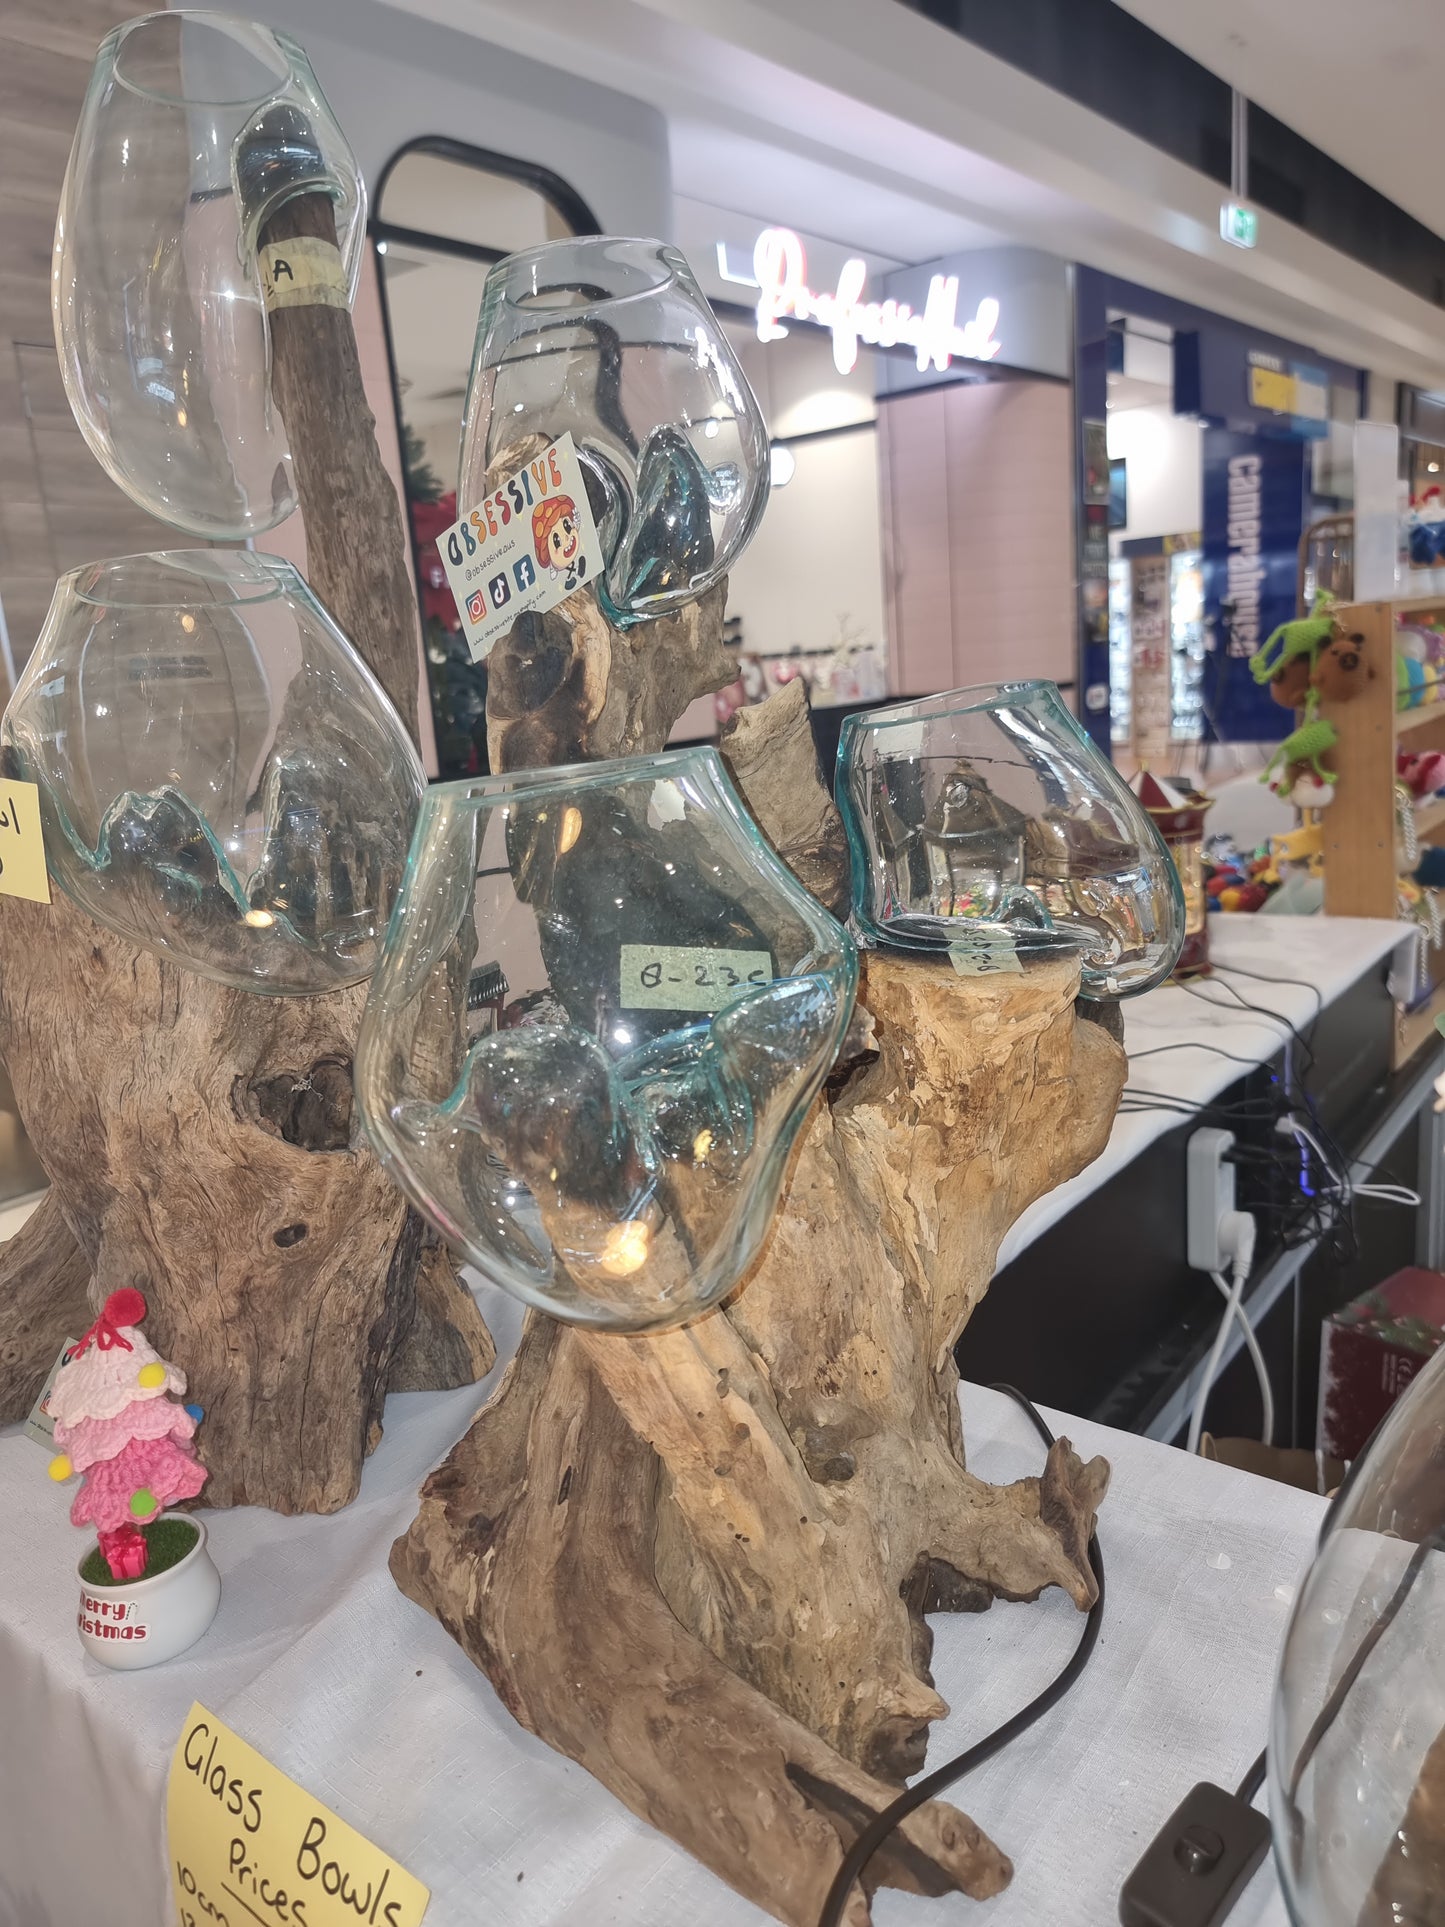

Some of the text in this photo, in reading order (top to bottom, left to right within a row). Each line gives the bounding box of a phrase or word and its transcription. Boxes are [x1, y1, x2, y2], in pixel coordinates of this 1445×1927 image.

[273, 259, 293, 282] A
[447, 448, 561, 566] OBSESSIVE
[184, 1723, 262, 1833] Glass
